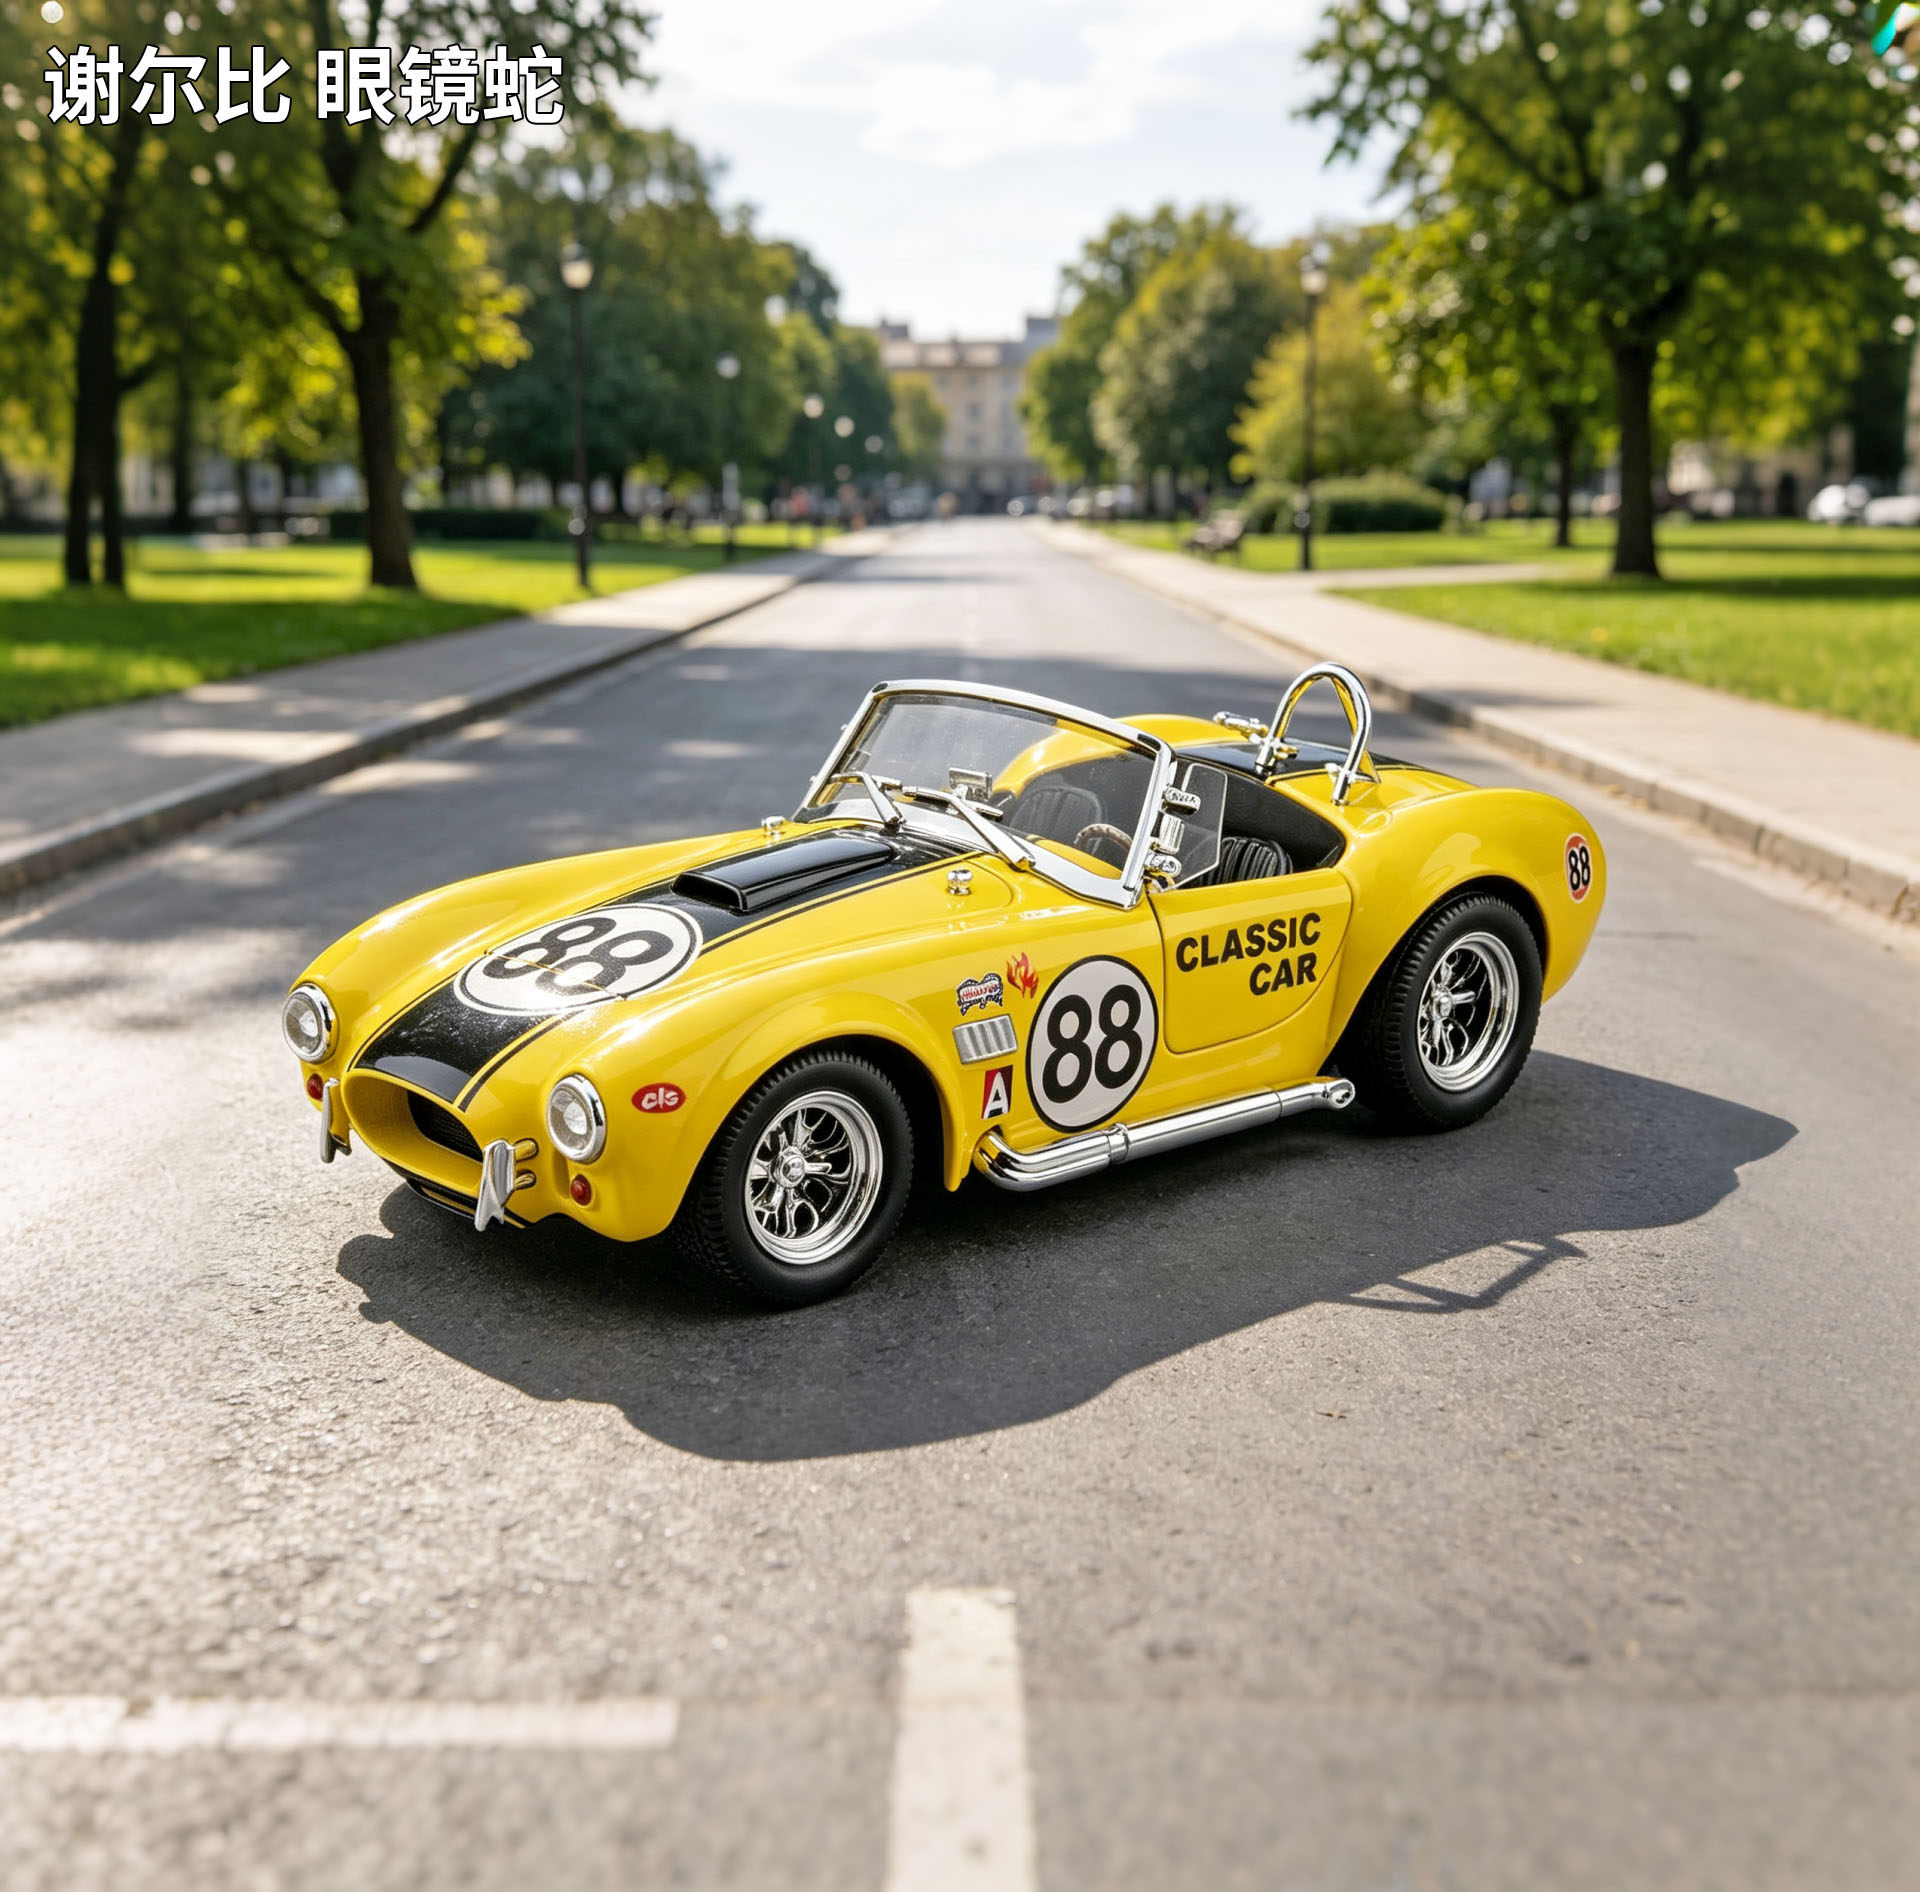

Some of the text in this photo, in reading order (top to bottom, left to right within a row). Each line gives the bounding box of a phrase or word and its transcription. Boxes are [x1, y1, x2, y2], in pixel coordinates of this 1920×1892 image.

[1568, 845, 1591, 890] 88
[482, 917, 674, 996] 88
[1176, 912, 1321, 972] CLASSIC
[1249, 952, 1317, 996] CAR
[1042, 984, 1142, 1104] 88
[983, 1071, 1008, 1119] A
